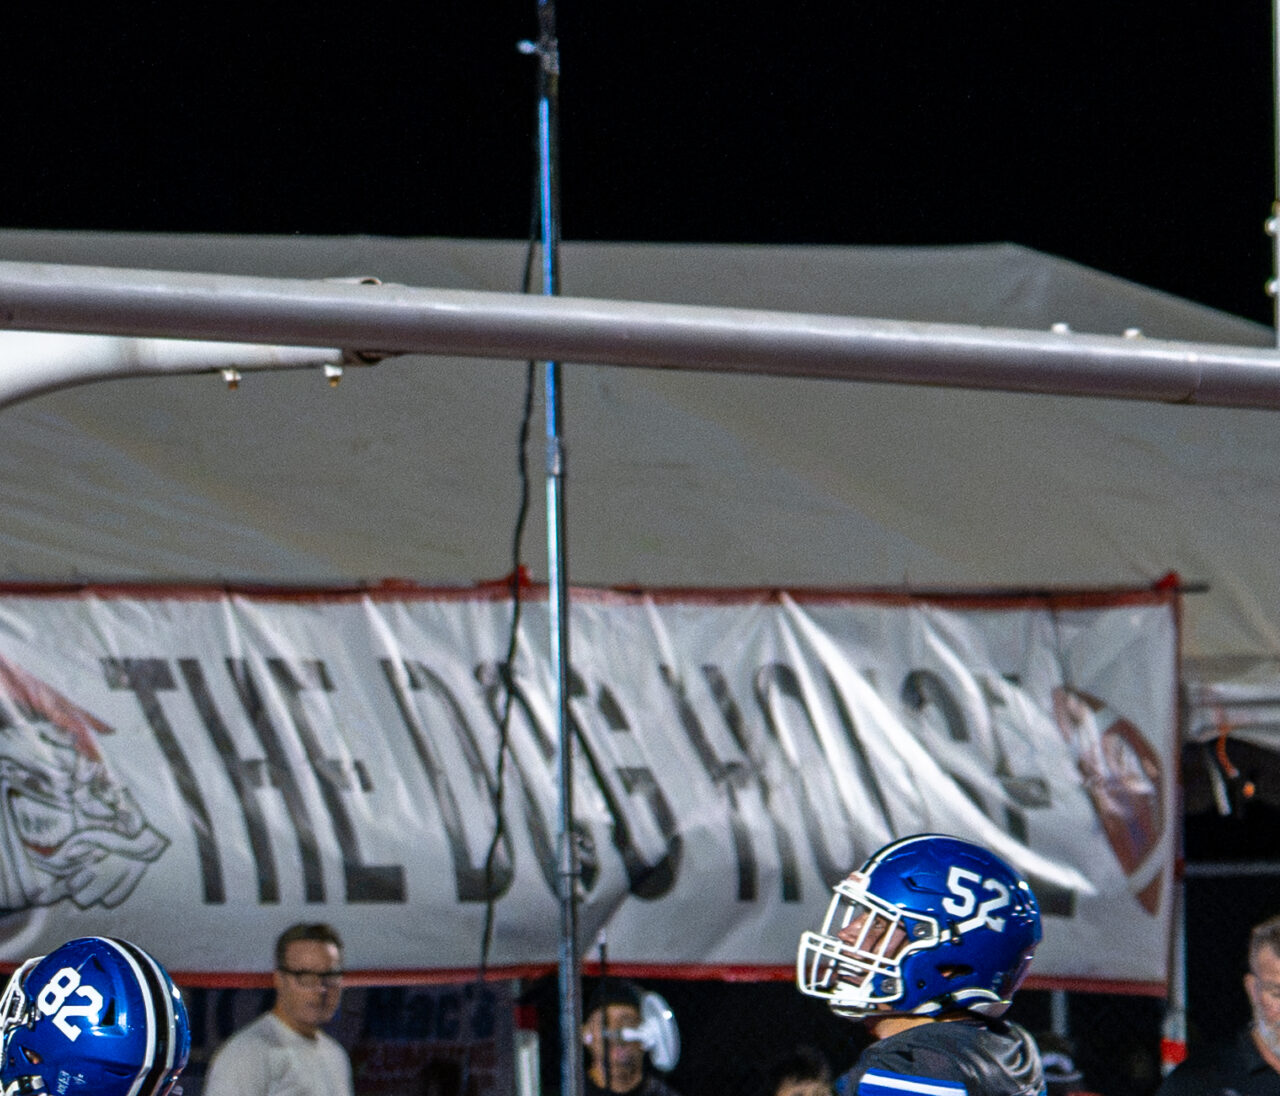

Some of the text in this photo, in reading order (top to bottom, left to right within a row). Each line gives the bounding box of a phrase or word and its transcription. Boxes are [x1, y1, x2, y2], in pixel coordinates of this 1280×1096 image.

[100, 657, 407, 904] THE
[942, 866, 1011, 934] 52
[37, 966, 105, 1042] 82
